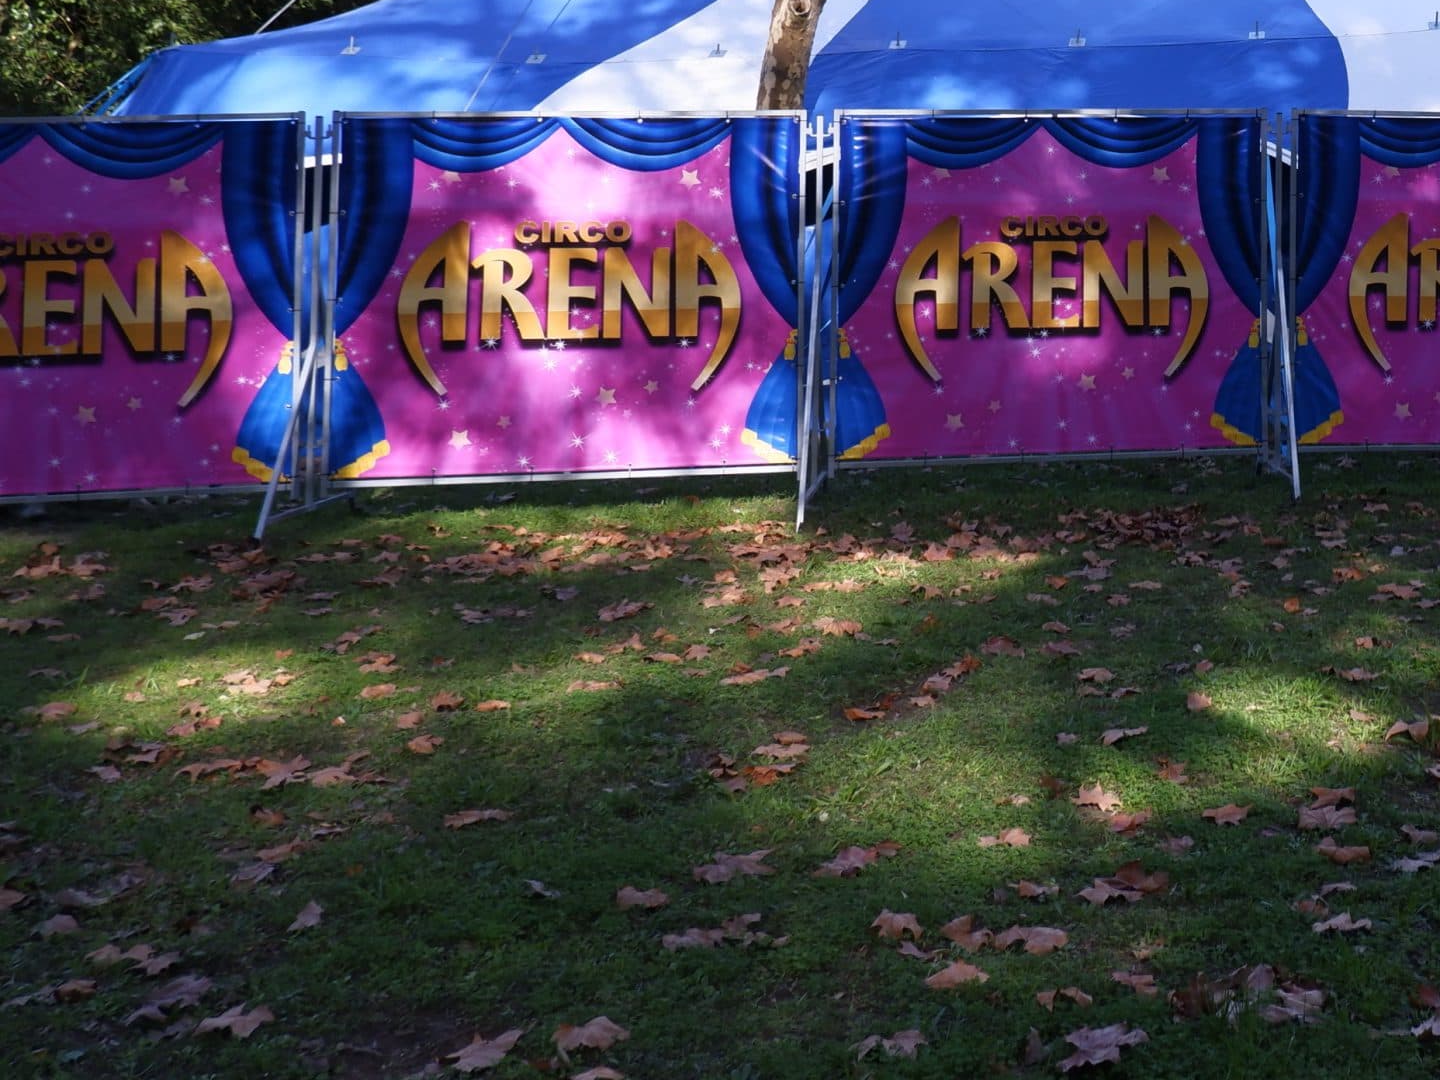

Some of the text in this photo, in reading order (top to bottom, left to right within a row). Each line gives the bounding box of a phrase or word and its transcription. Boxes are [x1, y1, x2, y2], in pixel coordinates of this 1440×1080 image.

[514, 220, 632, 244] CIRCO
[1000, 216, 1108, 237] CIRCO
[398, 220, 741, 396] ARENA
[895, 214, 1208, 381] ARENA
